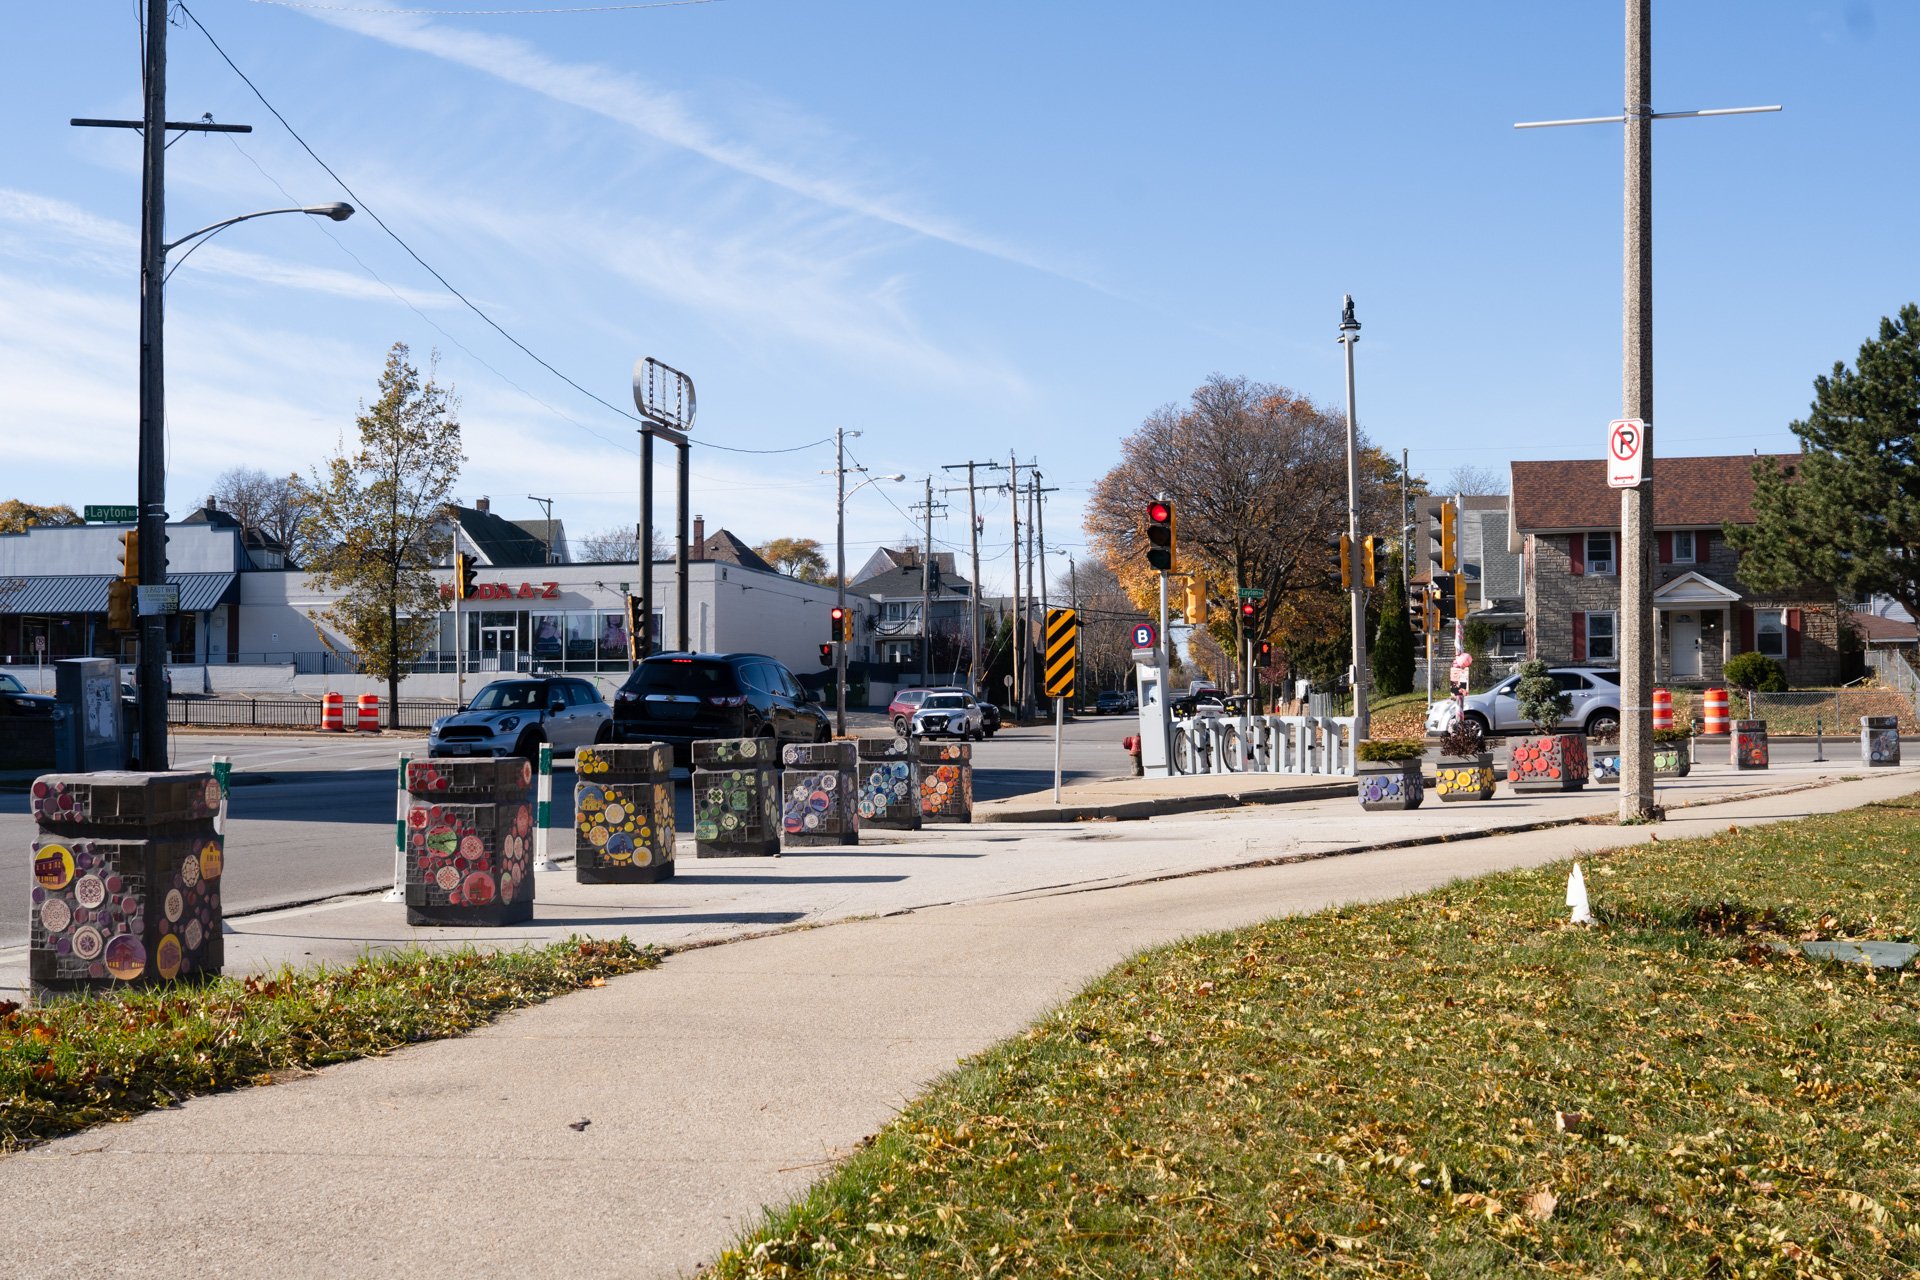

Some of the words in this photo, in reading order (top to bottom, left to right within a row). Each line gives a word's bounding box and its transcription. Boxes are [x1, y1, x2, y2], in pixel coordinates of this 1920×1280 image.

[91, 506, 127, 520] Layton
[517, 582, 559, 599] A-Z
[1241, 589, 1259, 597] Layton
[1137, 629, 1148, 643] B
